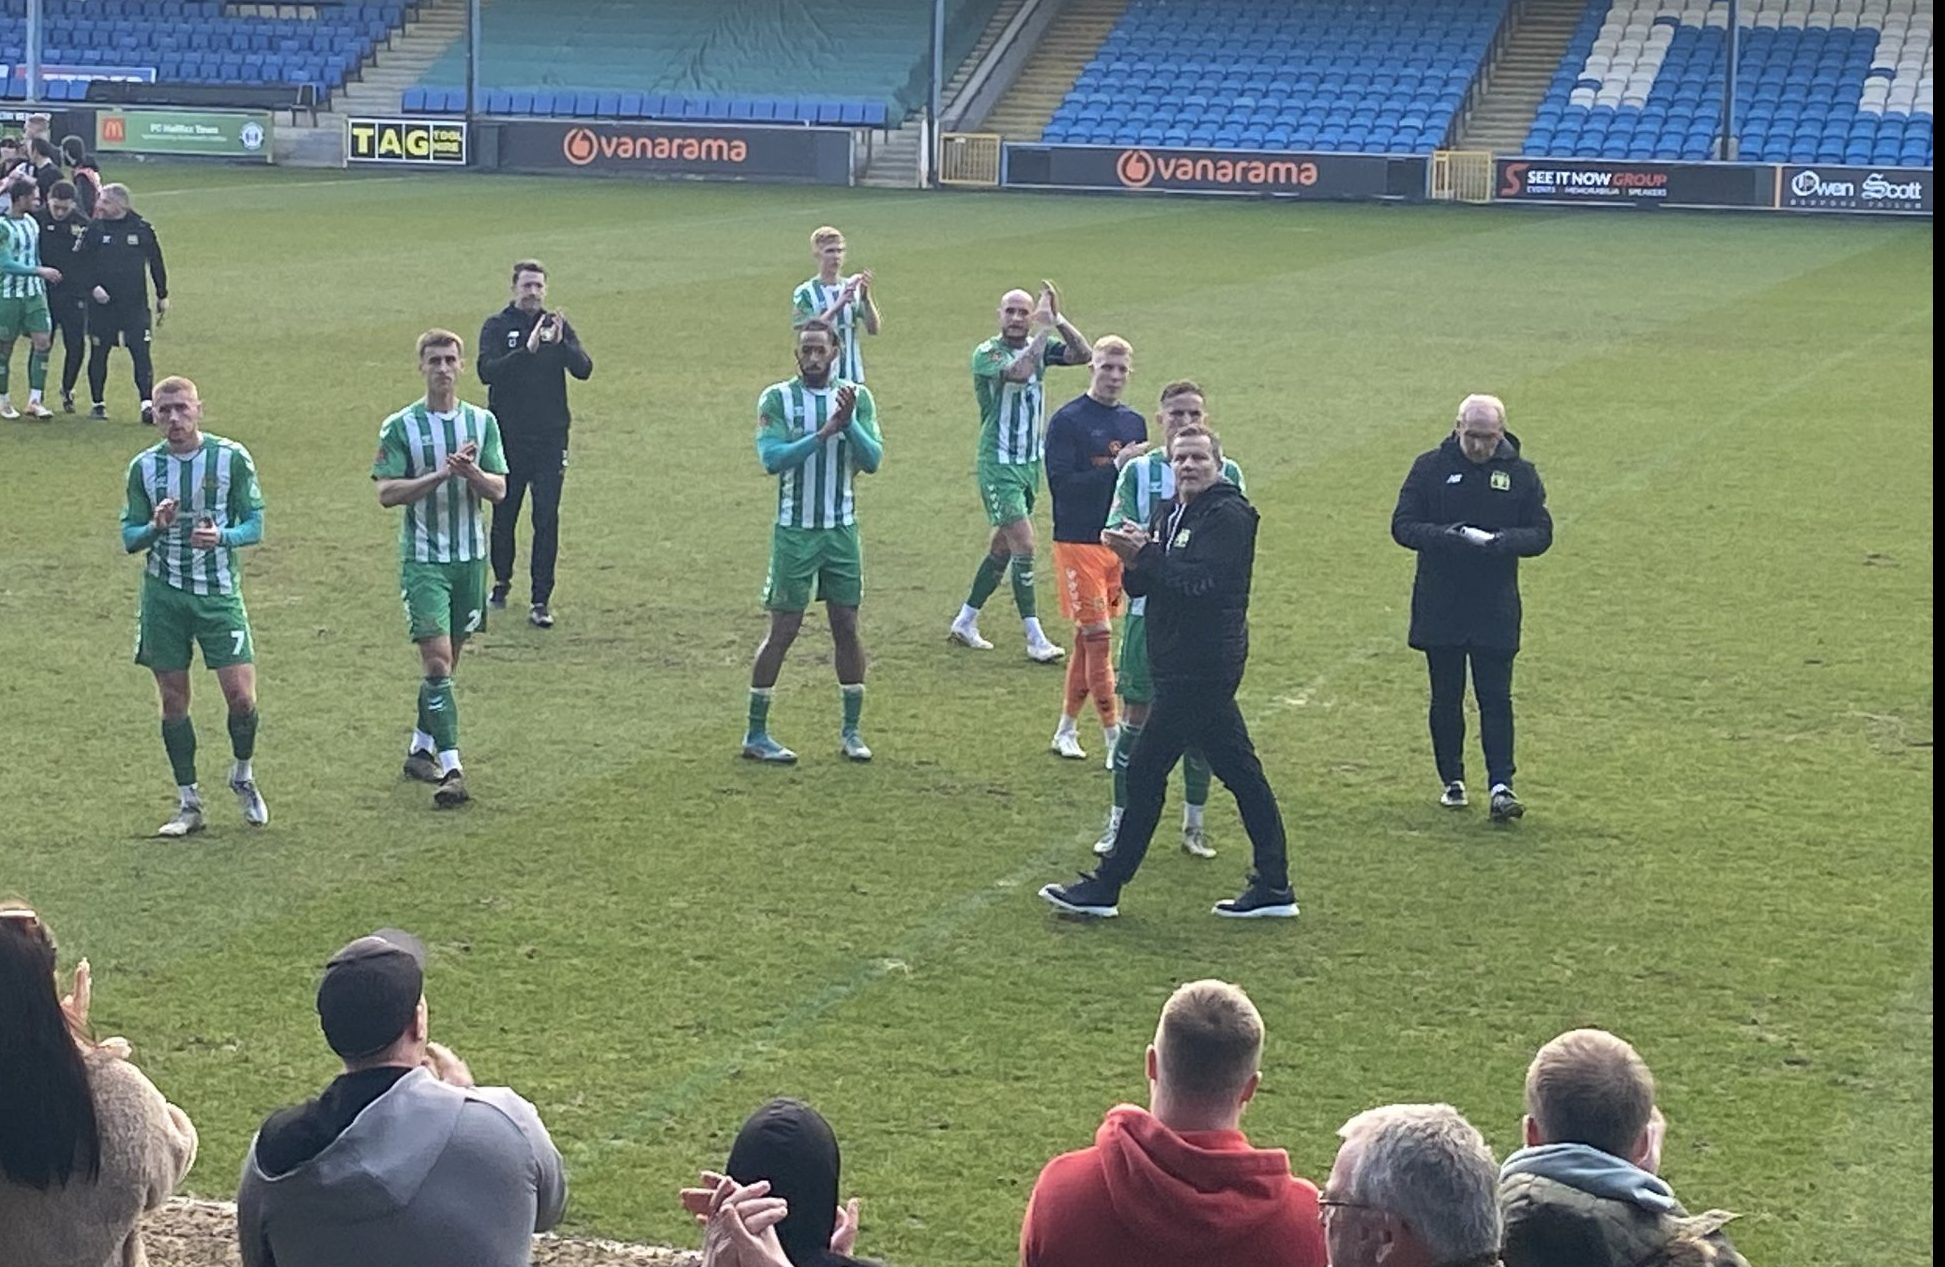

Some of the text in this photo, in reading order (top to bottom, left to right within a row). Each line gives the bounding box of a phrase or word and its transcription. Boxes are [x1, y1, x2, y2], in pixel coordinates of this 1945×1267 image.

[352, 127, 430, 156] TAG
[600, 136, 748, 162] vanarama
[1156, 157, 1318, 186] vanarama
[1527, 170, 1668, 187] SEE IT NOW GROUP
[1791, 170, 1922, 200] Owen Scott
[231, 630, 245, 656] 7
